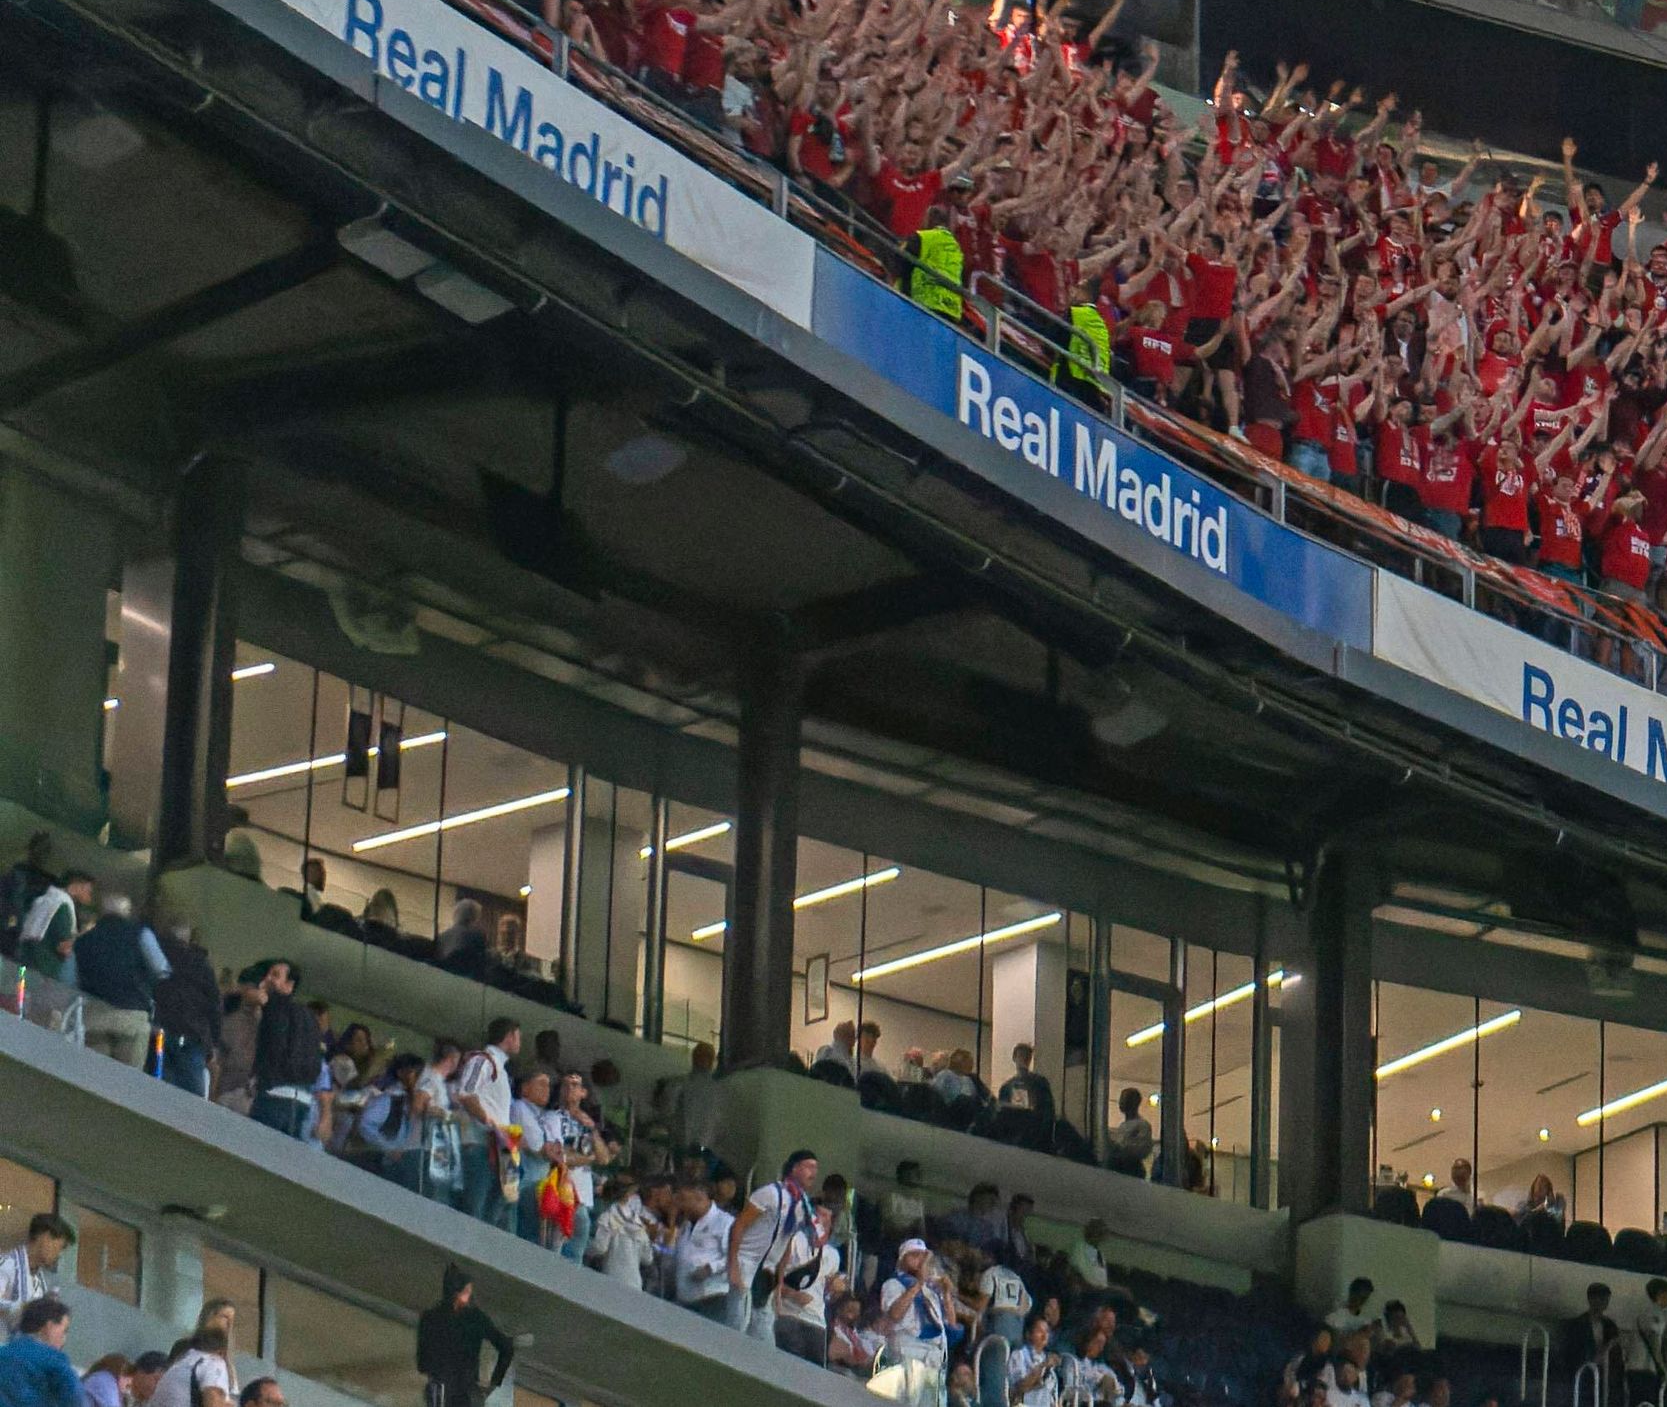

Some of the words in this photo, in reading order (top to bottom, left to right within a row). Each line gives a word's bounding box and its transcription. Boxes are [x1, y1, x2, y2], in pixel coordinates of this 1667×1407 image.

[485, 66, 669, 241] Madrid
[959, 352, 1060, 478] Real
[1074, 421, 1229, 575] Madrid
[1522, 661, 1628, 764] Real
